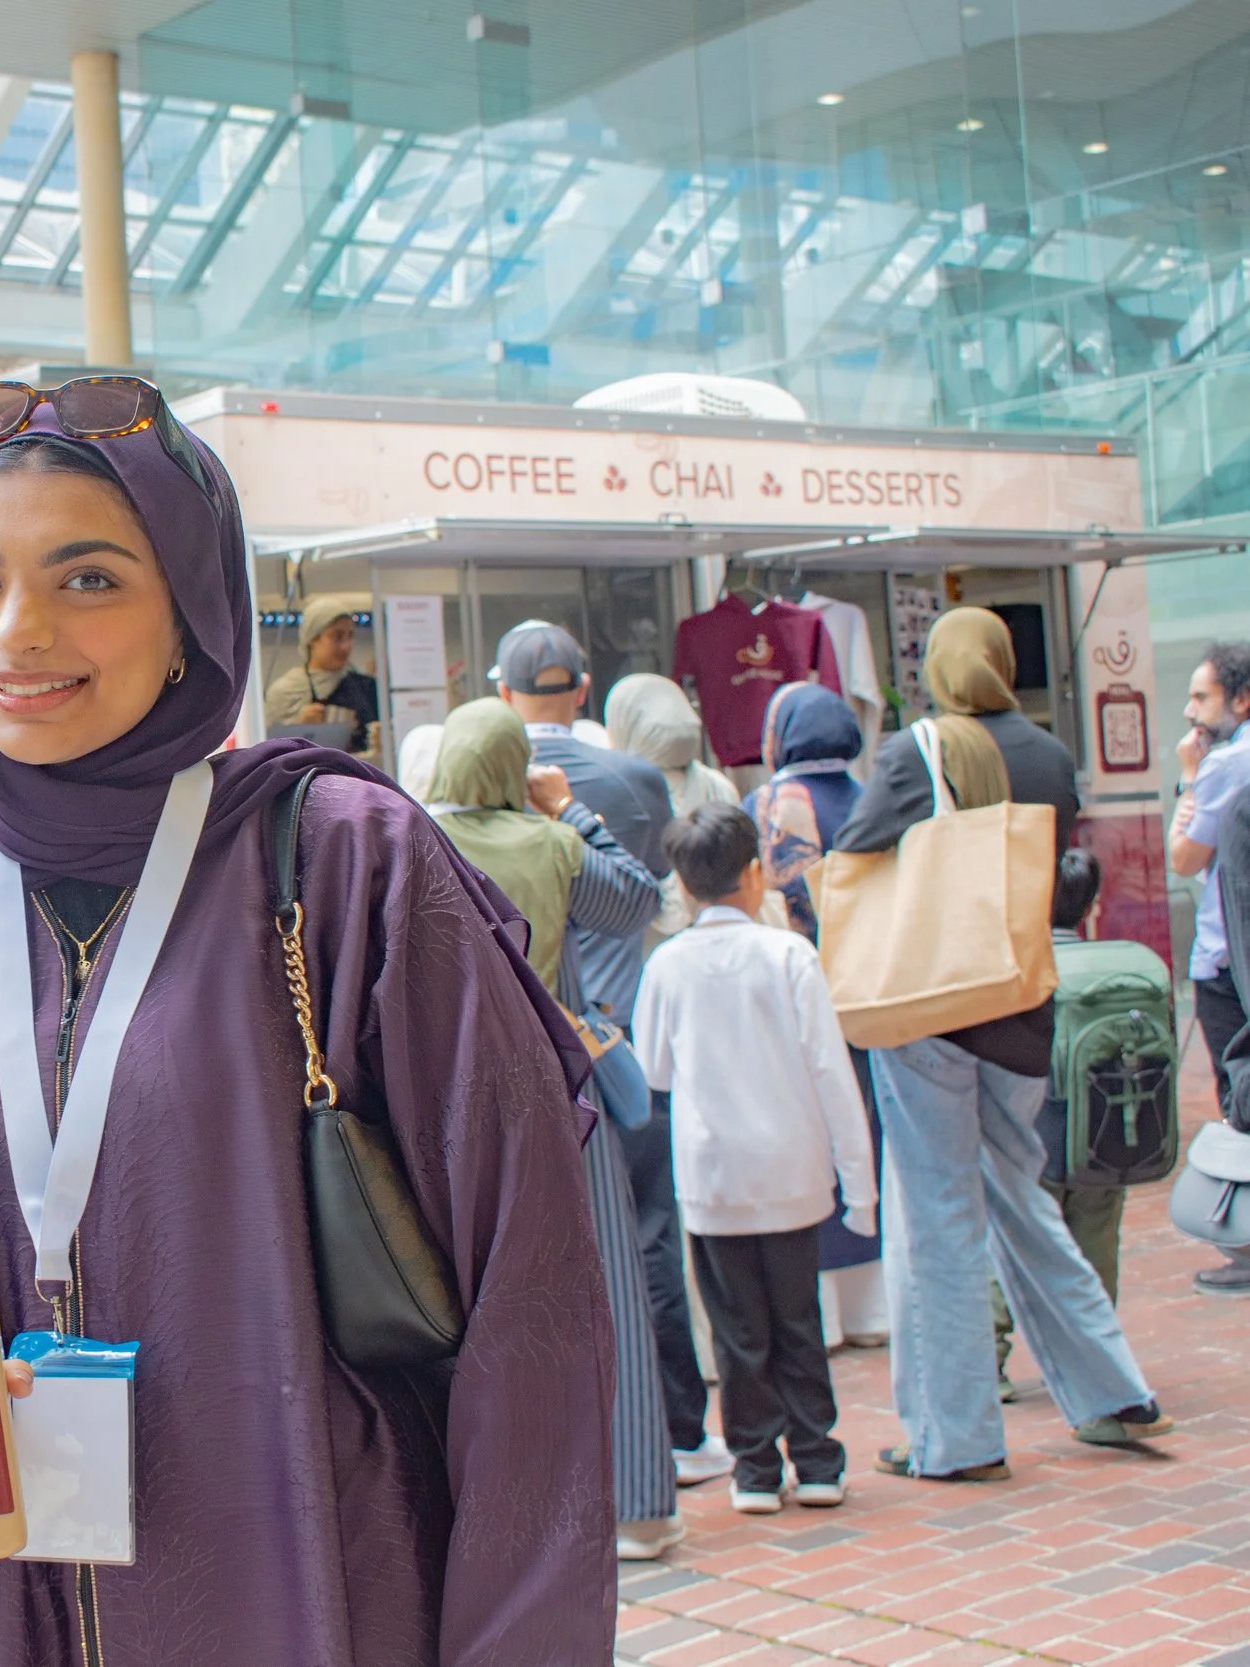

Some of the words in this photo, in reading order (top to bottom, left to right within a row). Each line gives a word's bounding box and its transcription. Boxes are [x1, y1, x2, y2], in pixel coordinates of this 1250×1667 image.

[423, 450, 577, 495] COFFEE
[649, 459, 735, 501] CHAI
[801, 467, 963, 508] DESSERTS
